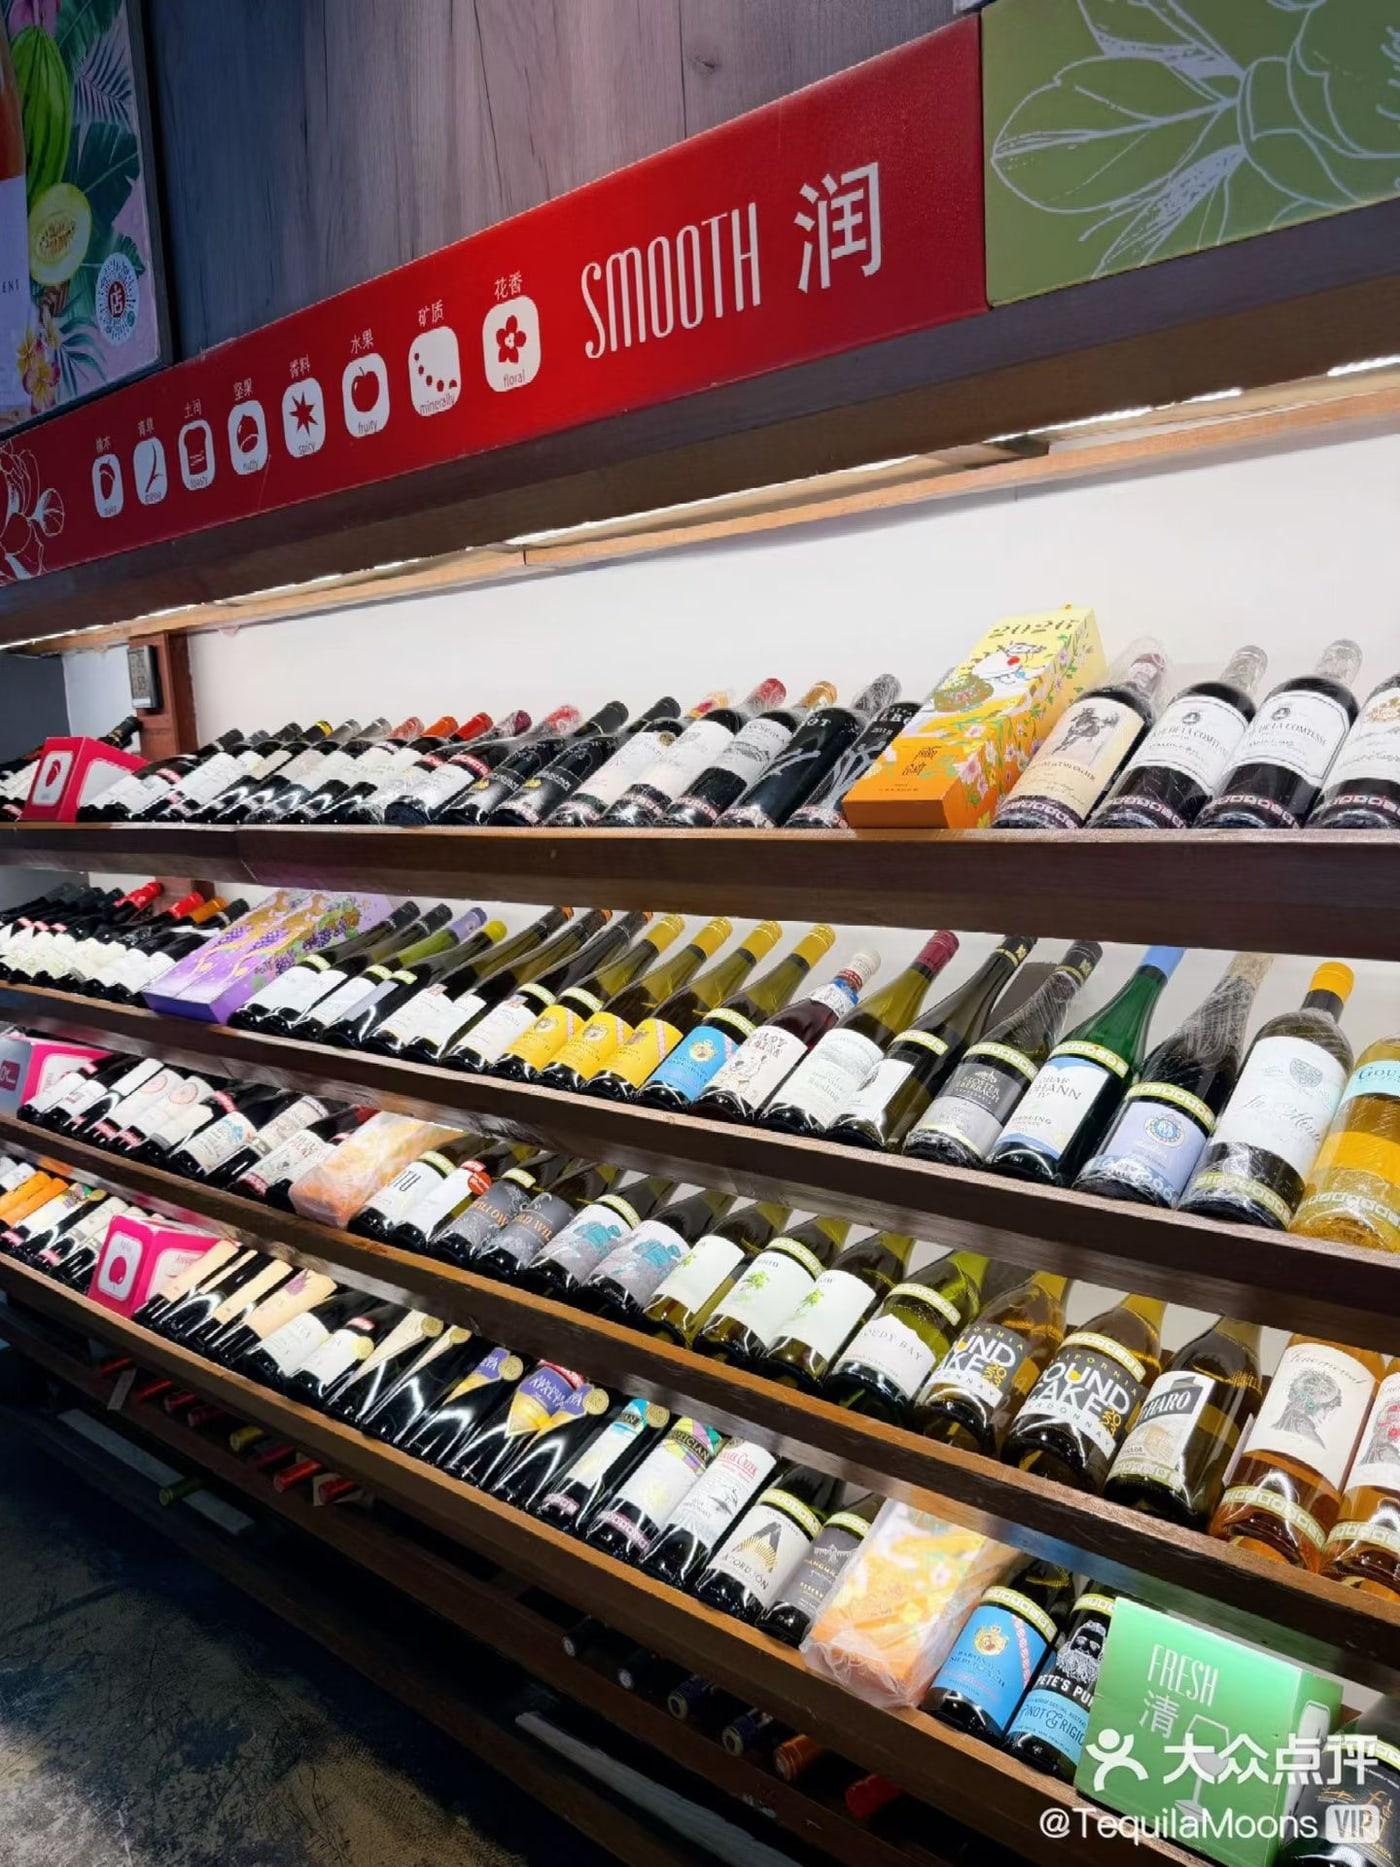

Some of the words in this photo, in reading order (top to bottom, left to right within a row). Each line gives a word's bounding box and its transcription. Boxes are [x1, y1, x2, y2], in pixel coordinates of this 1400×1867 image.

[793, 161, 882, 293] 润
[494, 270, 523, 299] 花香
[581, 202, 761, 359] SMOOTH
[417, 299, 444, 327] 矿质
[350, 328, 374, 353] 水果
[289, 354, 311, 378] 香料
[503, 369, 526, 388] floral
[233, 378, 254, 400] 坚果
[358, 419, 378, 434] fruity
[1034, 1674, 1071, 1693] PETE'S
[1147, 1644, 1220, 1707] FRESH
[1022, 1703, 1046, 1720] PINOT
[1139, 1690, 1181, 1740] 清
